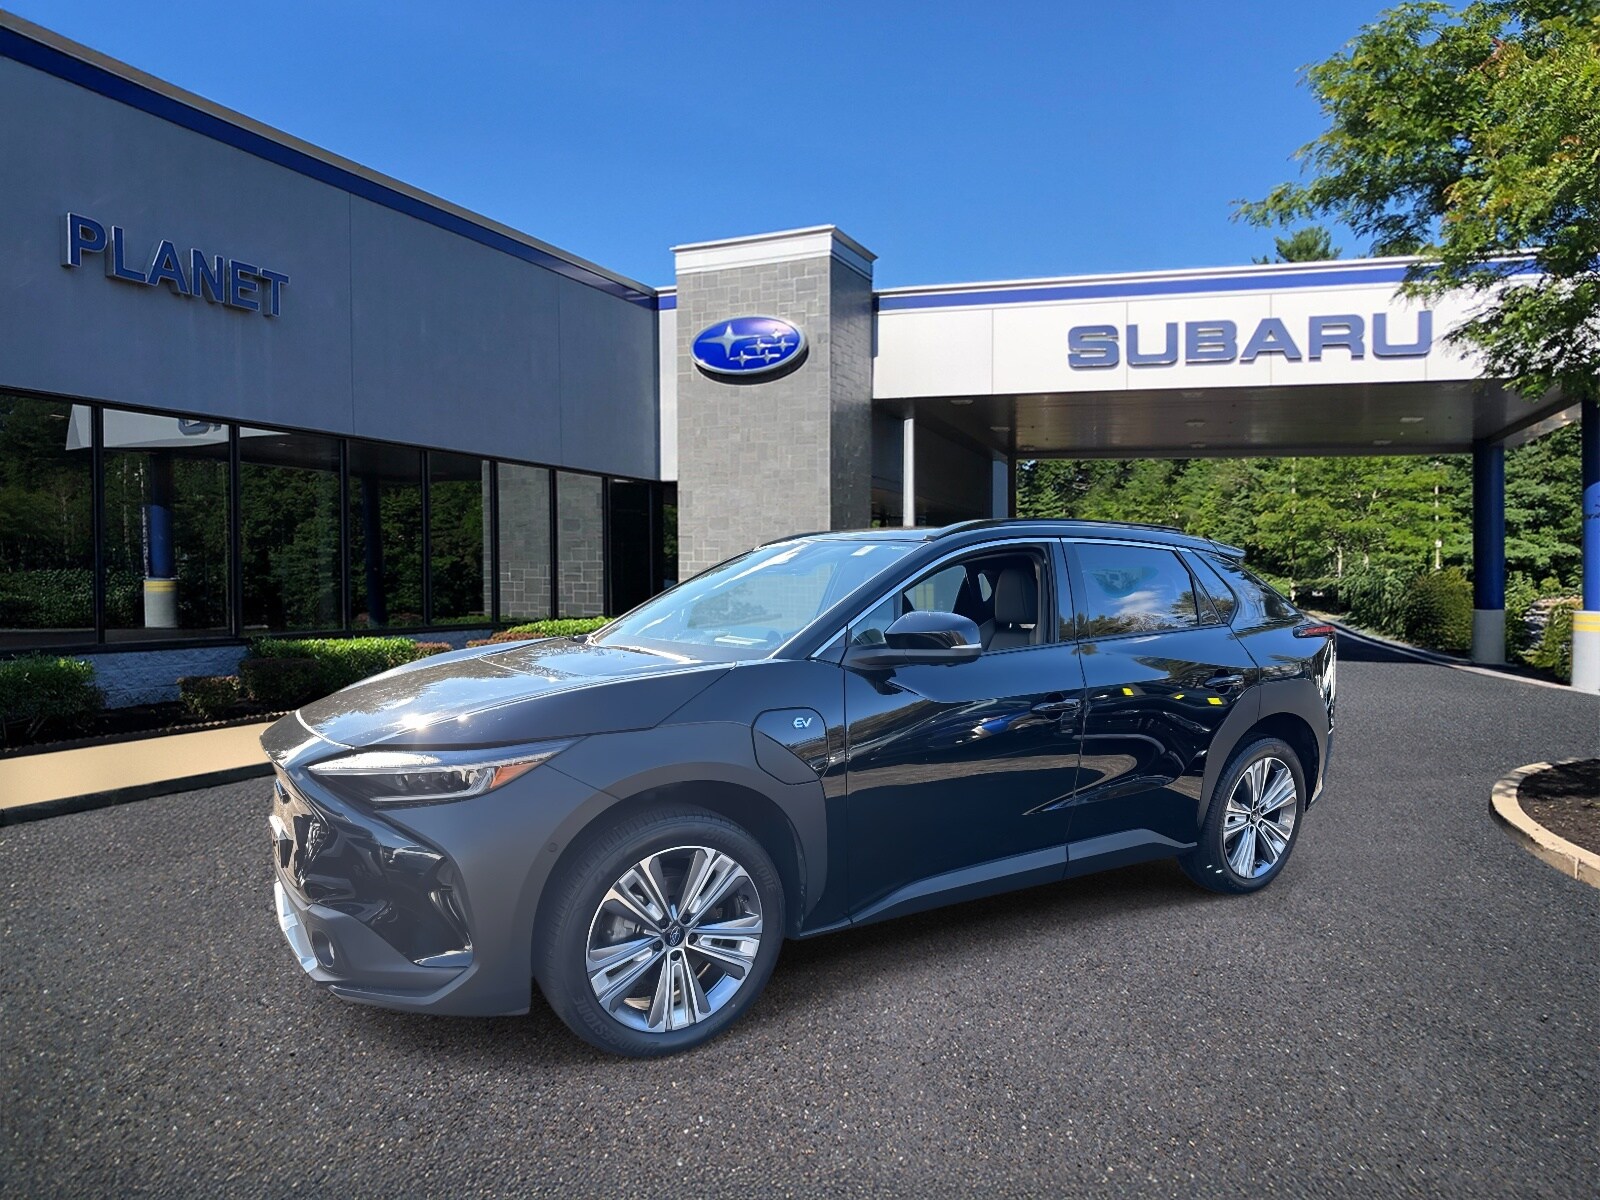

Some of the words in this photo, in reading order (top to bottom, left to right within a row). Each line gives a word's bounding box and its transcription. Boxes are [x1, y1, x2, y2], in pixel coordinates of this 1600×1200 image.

[64, 211, 290, 318] PLANET
[1066, 309, 1434, 370] SUBARU
[792, 716, 814, 728] EV
